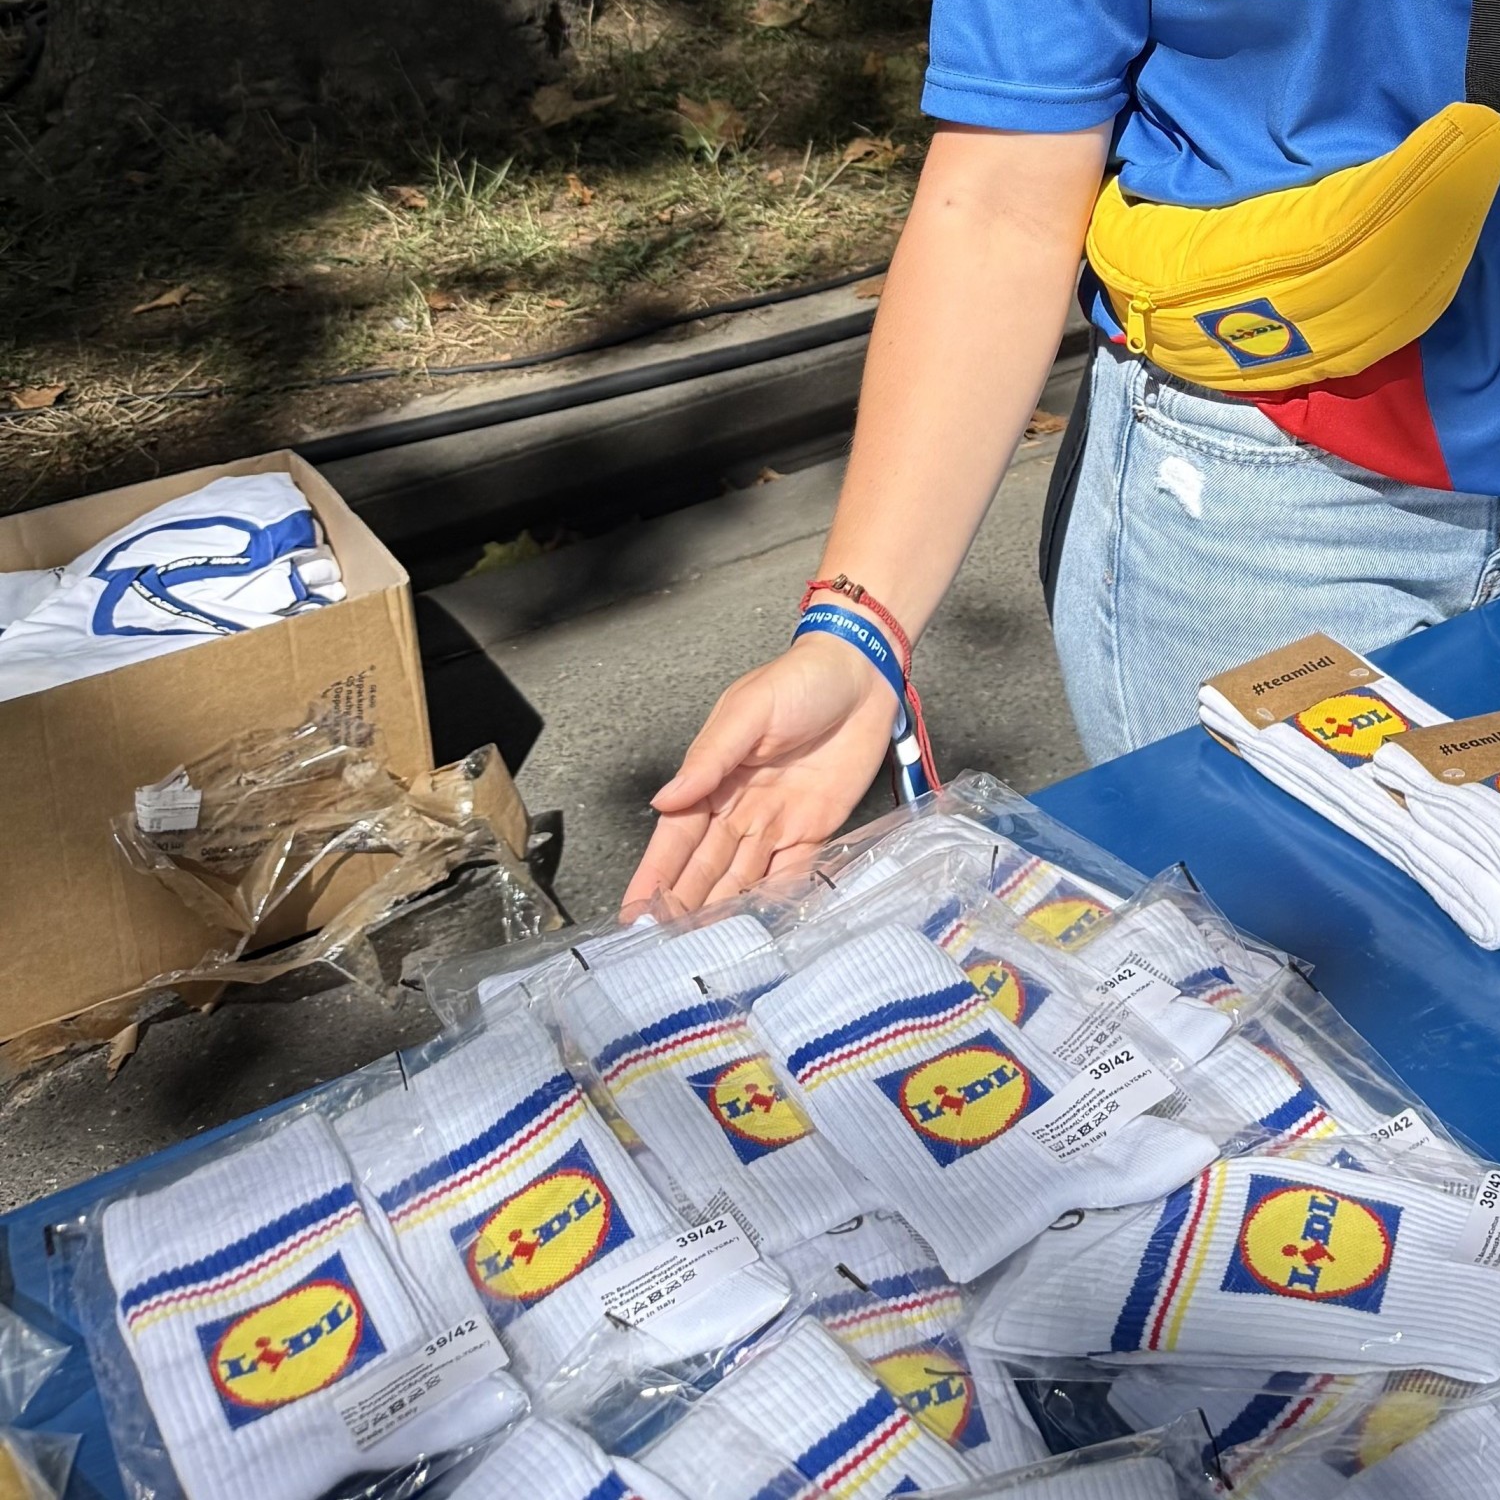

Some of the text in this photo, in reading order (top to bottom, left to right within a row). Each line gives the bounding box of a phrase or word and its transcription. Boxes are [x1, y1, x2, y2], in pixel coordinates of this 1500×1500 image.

[1252, 655, 1336, 696] #teamlidl
[1089, 1050, 1134, 1080] 39/42
[1090, 1130, 1107, 1143] Italy
[676, 1219, 727, 1248] 39/42
[656, 1297, 676, 1312] Italy
[425, 1319, 479, 1357] 39/42
